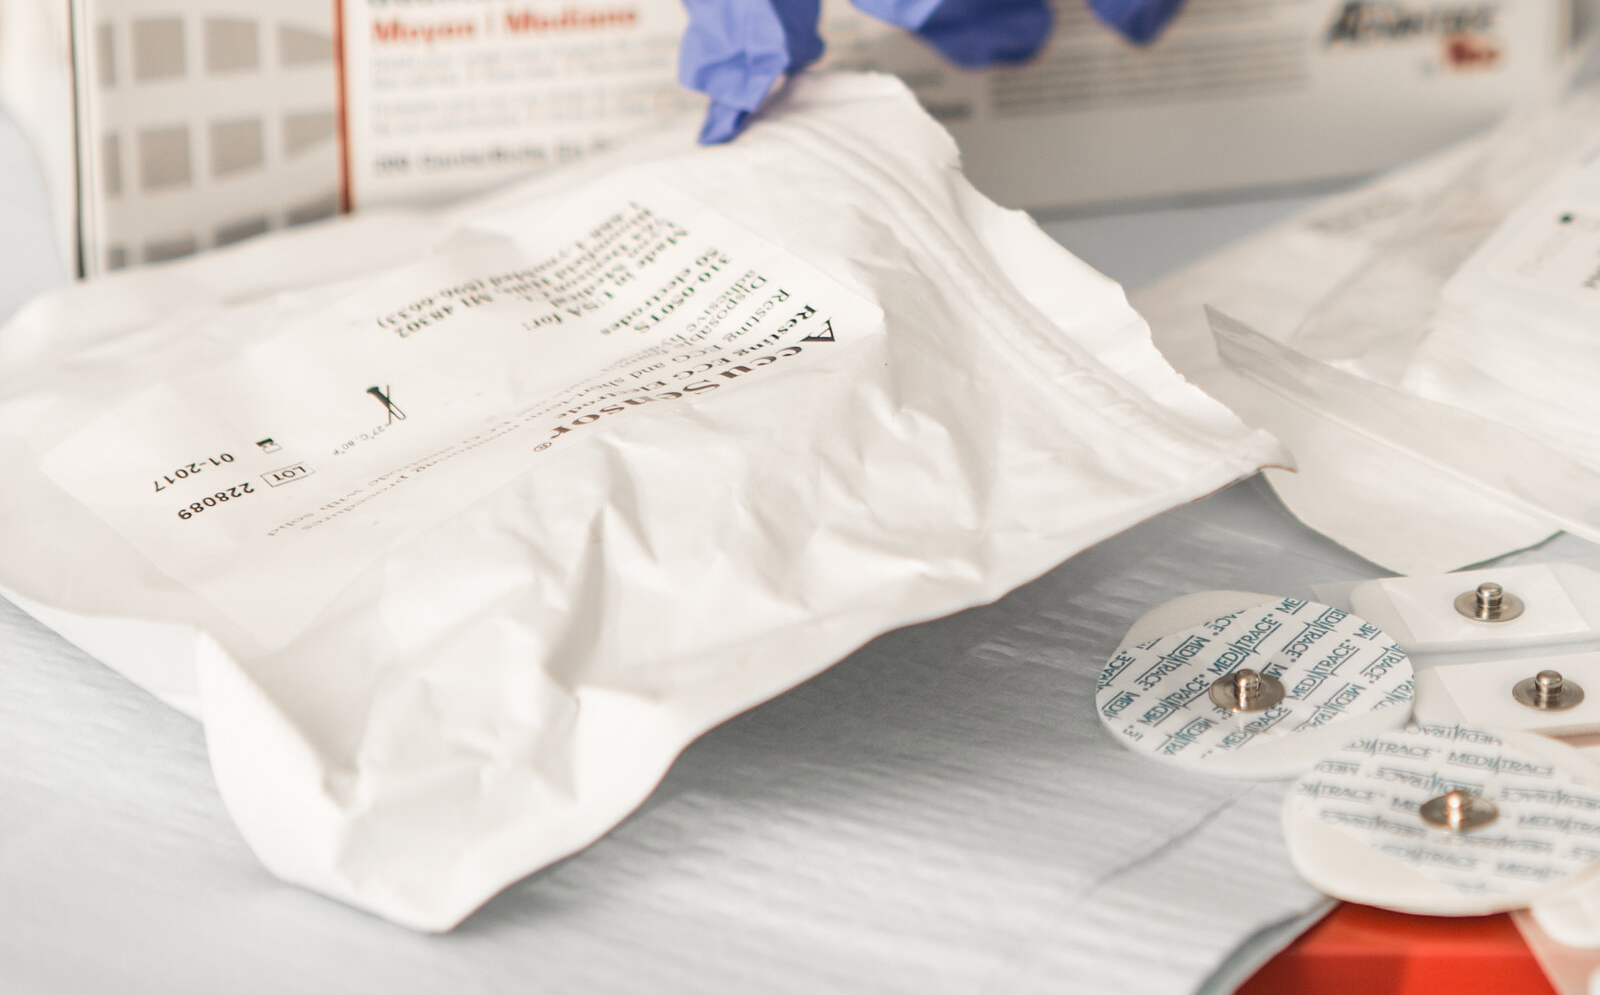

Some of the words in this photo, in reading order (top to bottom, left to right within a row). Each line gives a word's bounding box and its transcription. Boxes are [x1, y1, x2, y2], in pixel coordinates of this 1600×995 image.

[637, 228, 689, 269] Made
[694, 247, 719, 269] 50
[613, 271, 635, 288] in
[631, 253, 731, 336] 310-050TS
[566, 290, 614, 319] USA
[599, 267, 691, 337] electrodes
[674, 274, 767, 351] Disposable
[722, 288, 791, 344] Resting
[731, 304, 817, 357] Resting
[629, 362, 666, 380] and
[671, 344, 722, 364] ECG
[673, 356, 730, 381] ECG
[555, 381, 667, 419] Electrode
[151, 452, 235, 493] 01-2017
[271, 465, 306, 483] LOT
[176, 482, 255, 521] 228089
